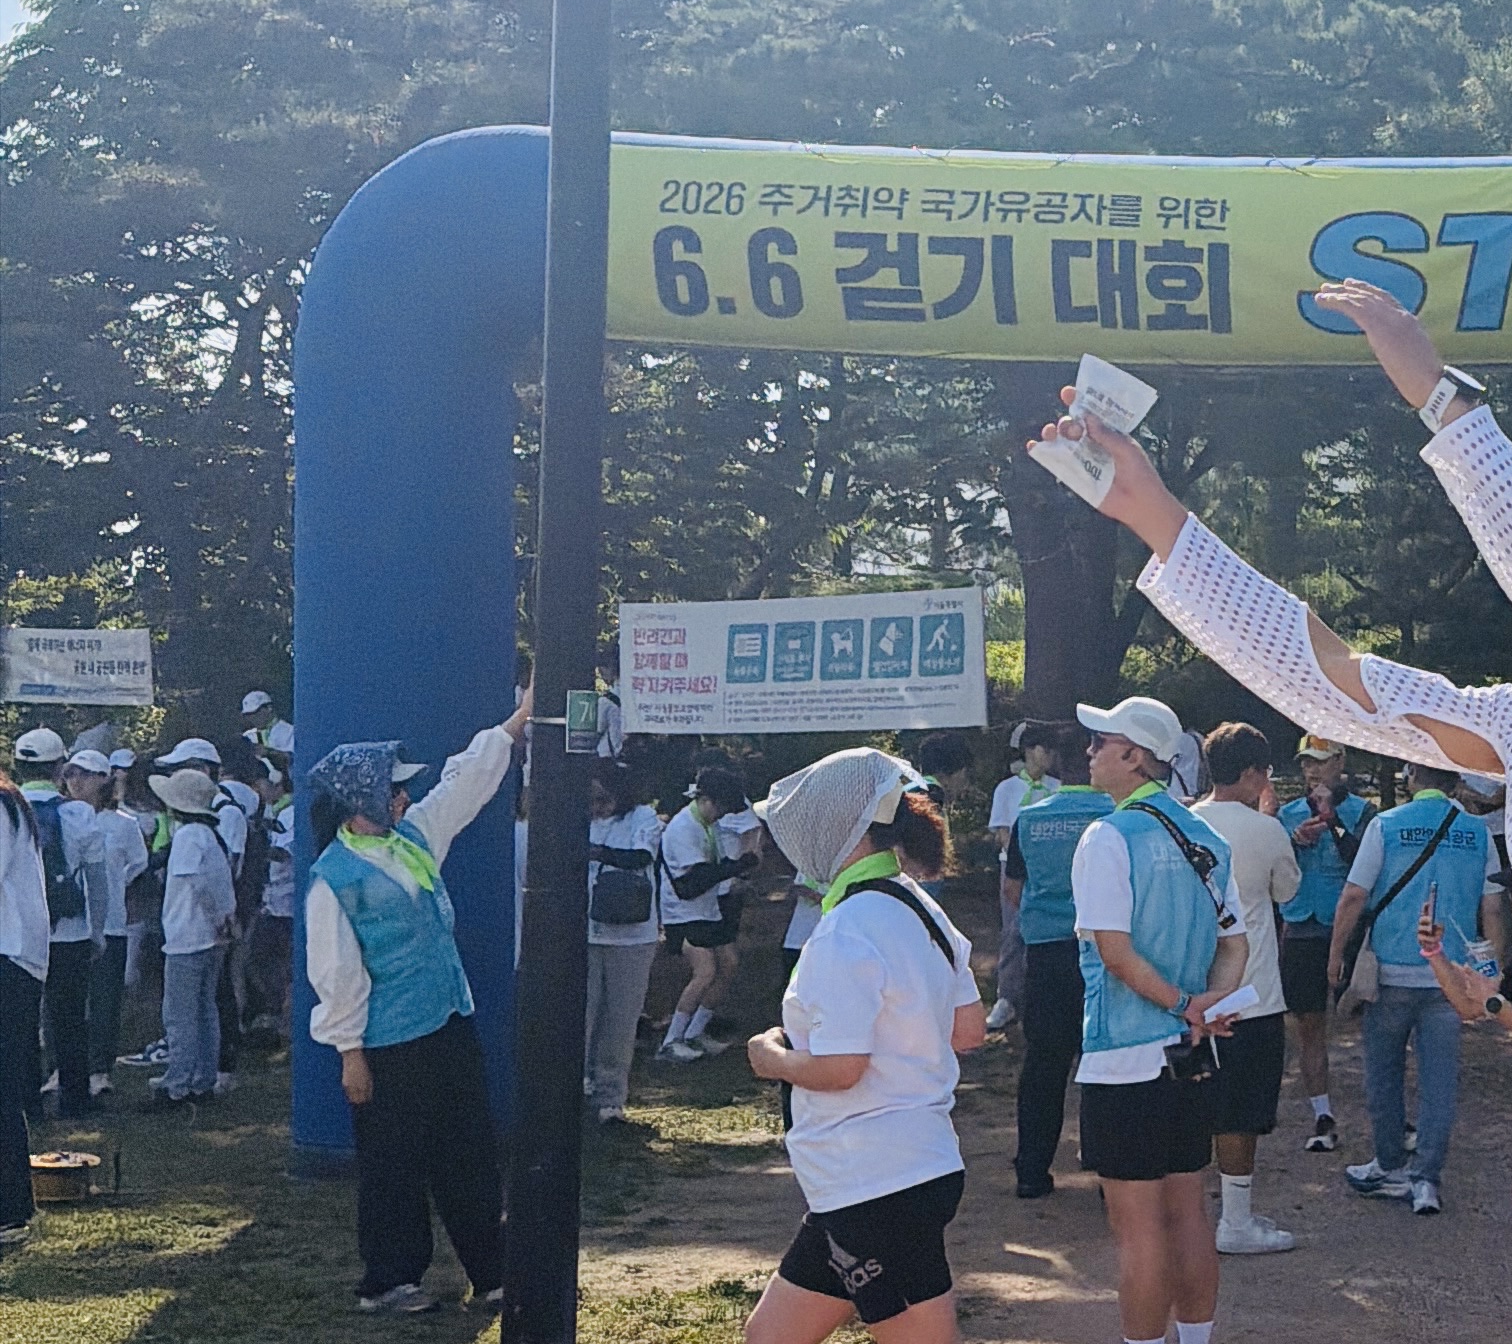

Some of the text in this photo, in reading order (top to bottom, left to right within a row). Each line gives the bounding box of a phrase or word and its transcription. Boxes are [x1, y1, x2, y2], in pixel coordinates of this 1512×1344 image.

[660, 179, 1230, 232] 2026 주거취약 국가유공자를 위한
[653, 225, 1232, 334] 6.6 걷기 대회
[647, 675, 718, 694] 지켜주세요!
